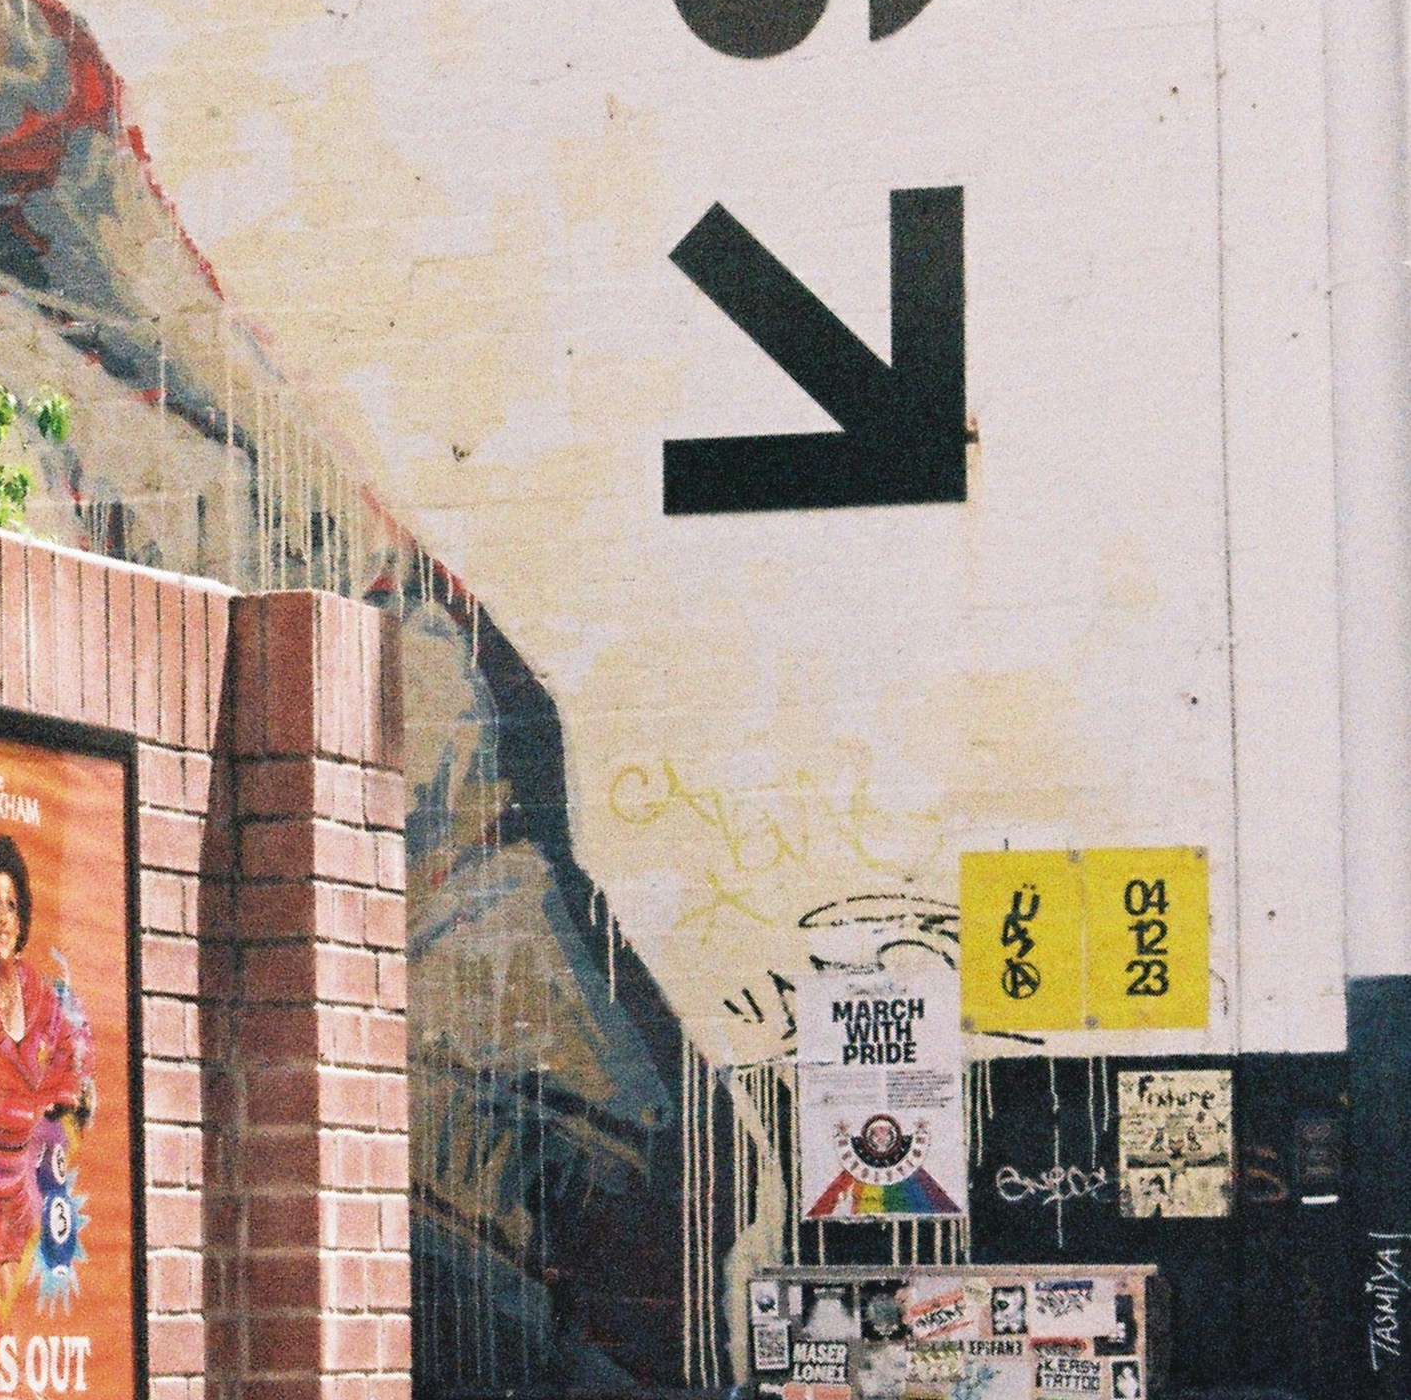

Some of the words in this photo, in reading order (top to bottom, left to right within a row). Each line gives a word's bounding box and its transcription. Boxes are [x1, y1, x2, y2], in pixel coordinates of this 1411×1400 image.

[1124, 878, 1170, 917] 04
[1128, 919, 1169, 956] 12
[1125, 959, 1170, 997] 23
[832, 998, 925, 1022] MARCH
[844, 1020, 913, 1044] WITH
[842, 1041, 918, 1066] PRIDE
[25, 1335, 92, 1393] OUT
